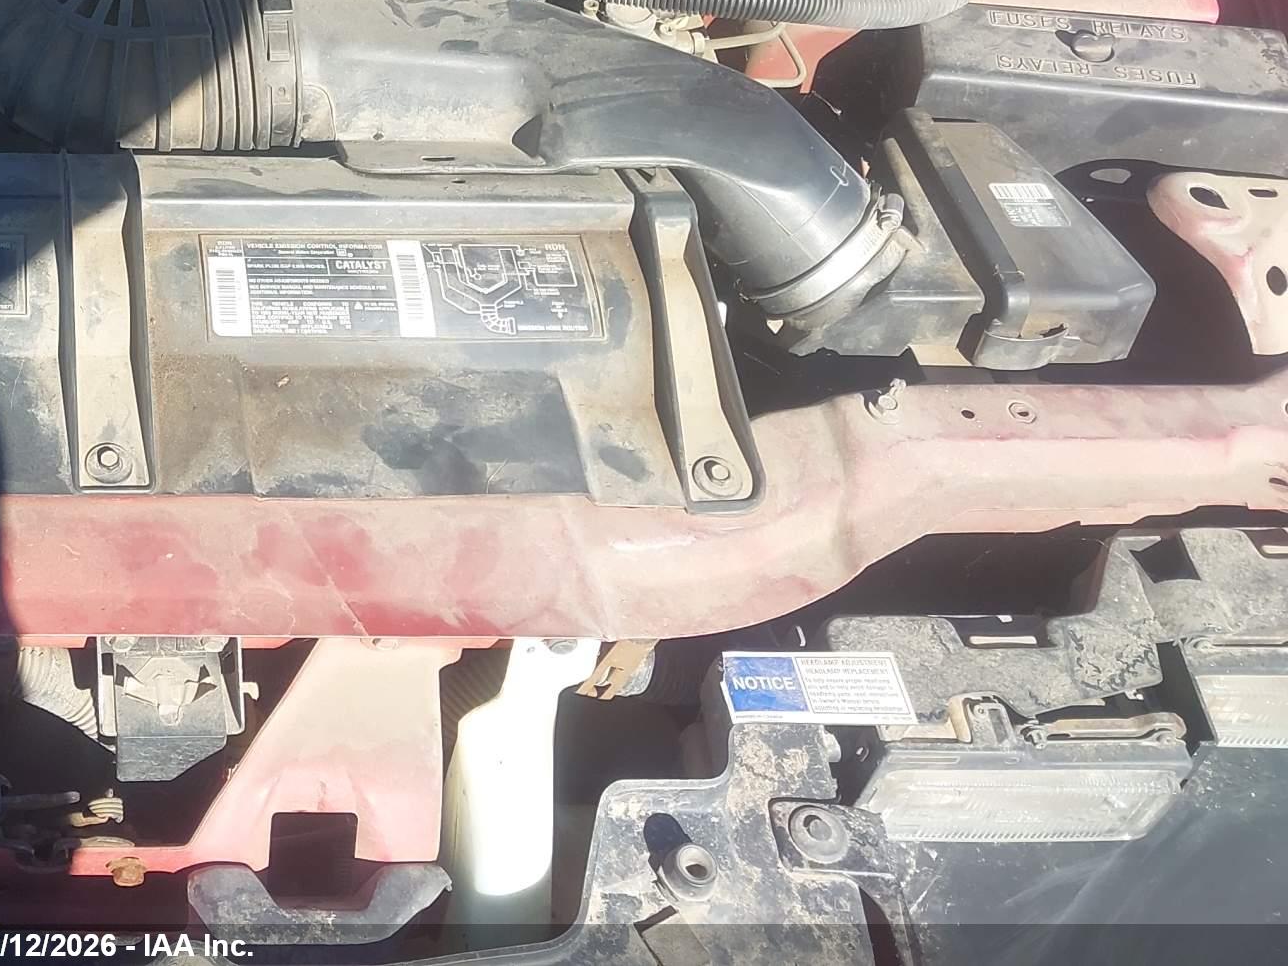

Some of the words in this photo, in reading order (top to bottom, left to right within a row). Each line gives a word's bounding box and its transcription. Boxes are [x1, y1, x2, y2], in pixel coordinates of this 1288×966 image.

[990, 11, 1071, 31] FUSES
[1092, 20, 1186, 40] RELAYS
[999, 54, 1091, 75] RELAYS
[1113, 65, 1197, 86] FUSES
[335, 261, 388, 270] CATALYST
[732, 677, 796, 690] NOTICE
